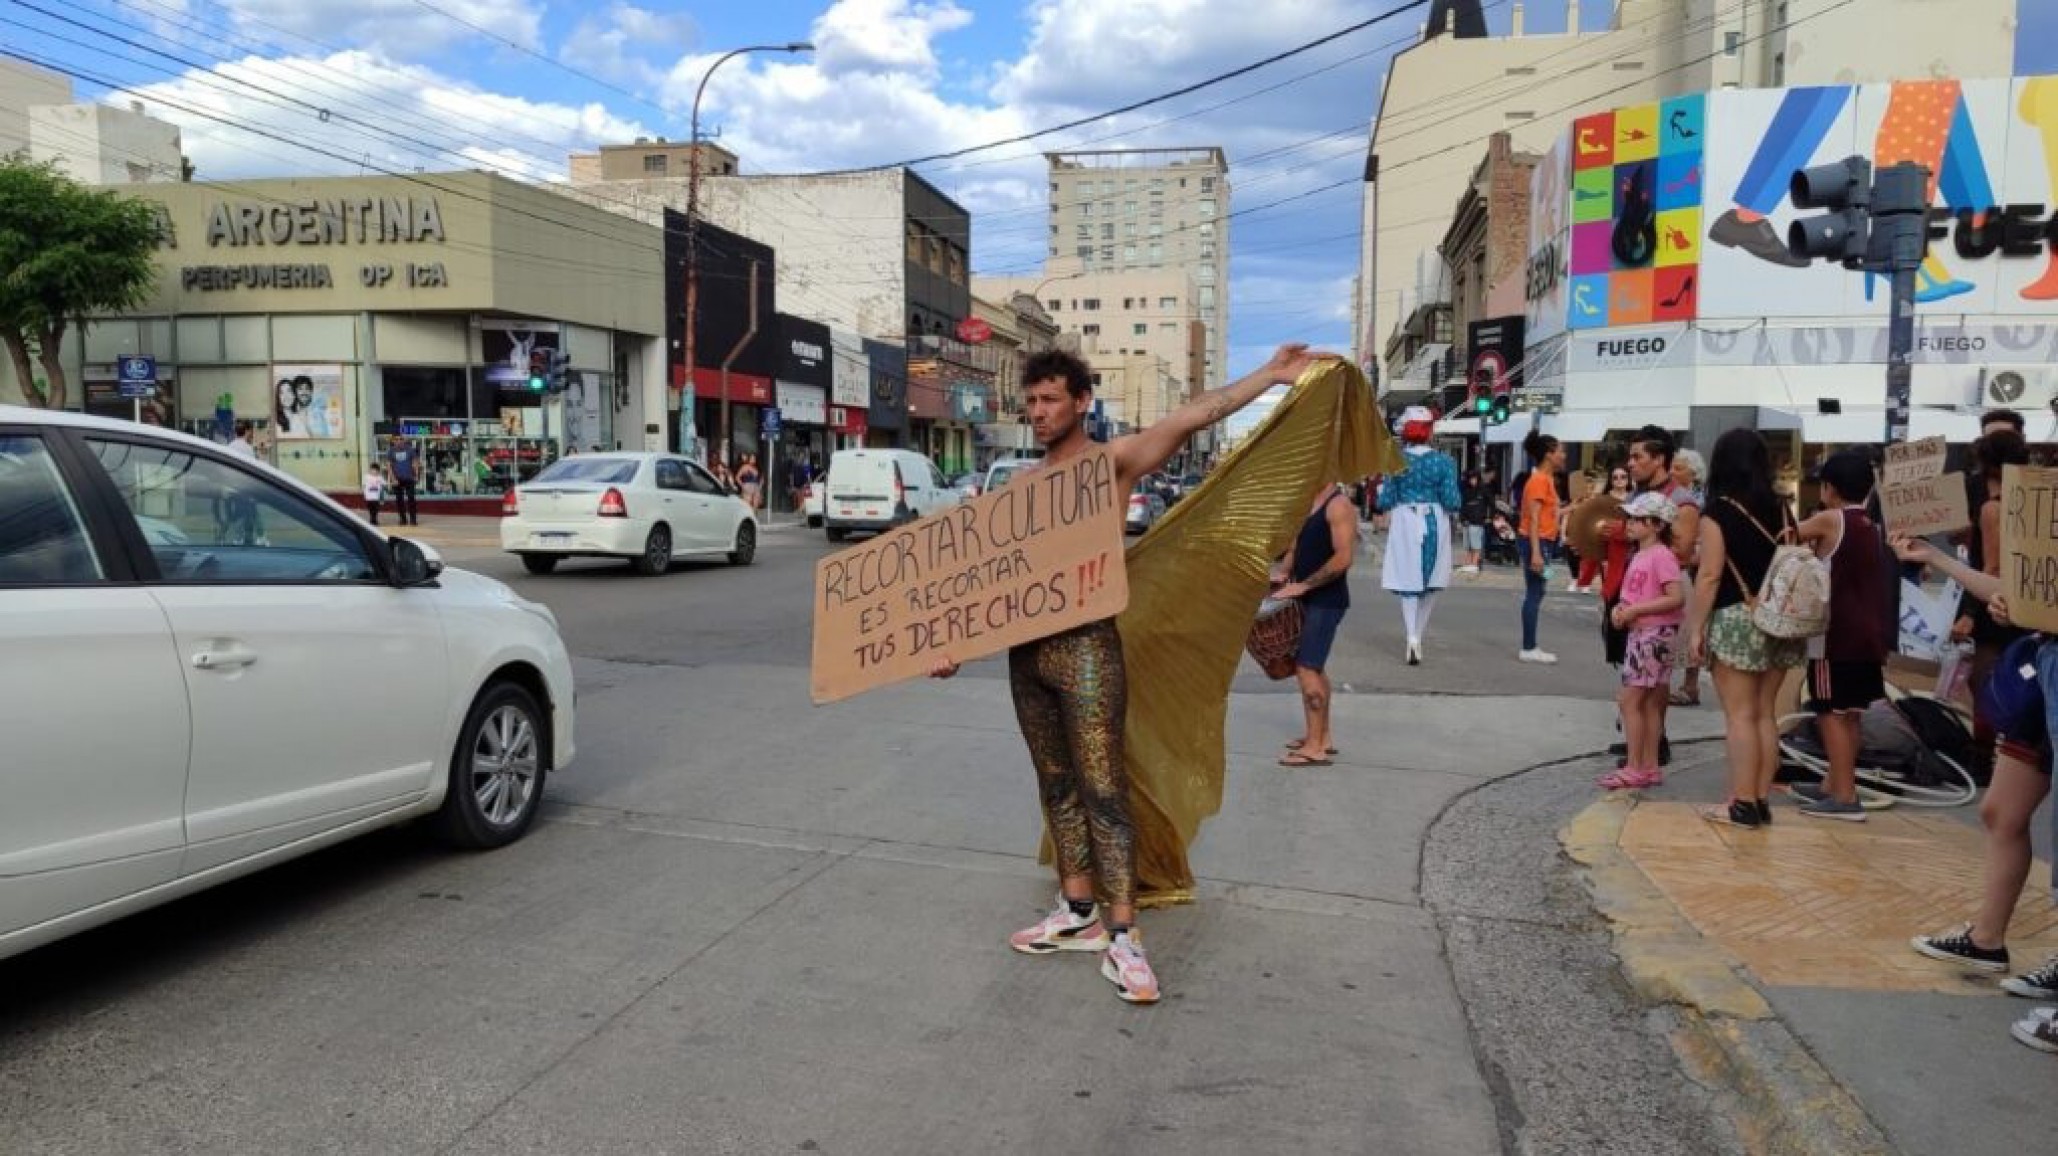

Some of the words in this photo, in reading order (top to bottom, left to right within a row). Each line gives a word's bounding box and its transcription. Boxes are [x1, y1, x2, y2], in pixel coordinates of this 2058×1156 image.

[206, 196, 446, 248] ARGENTINA
[1924, 203, 2058, 260] FUE
[182, 263, 334, 293] PERFUMERIA
[1597, 337, 1666, 357] FUEGO
[1918, 337, 1986, 351] FUEGO
[825, 504, 982, 611] RECORTAR
[988, 452, 1113, 548] CULTURA
[860, 602, 888, 635] ES
[908, 548, 1032, 612] RECORTAR
[854, 634, 897, 668] TUS
[904, 572, 1067, 656] DERECHOS
